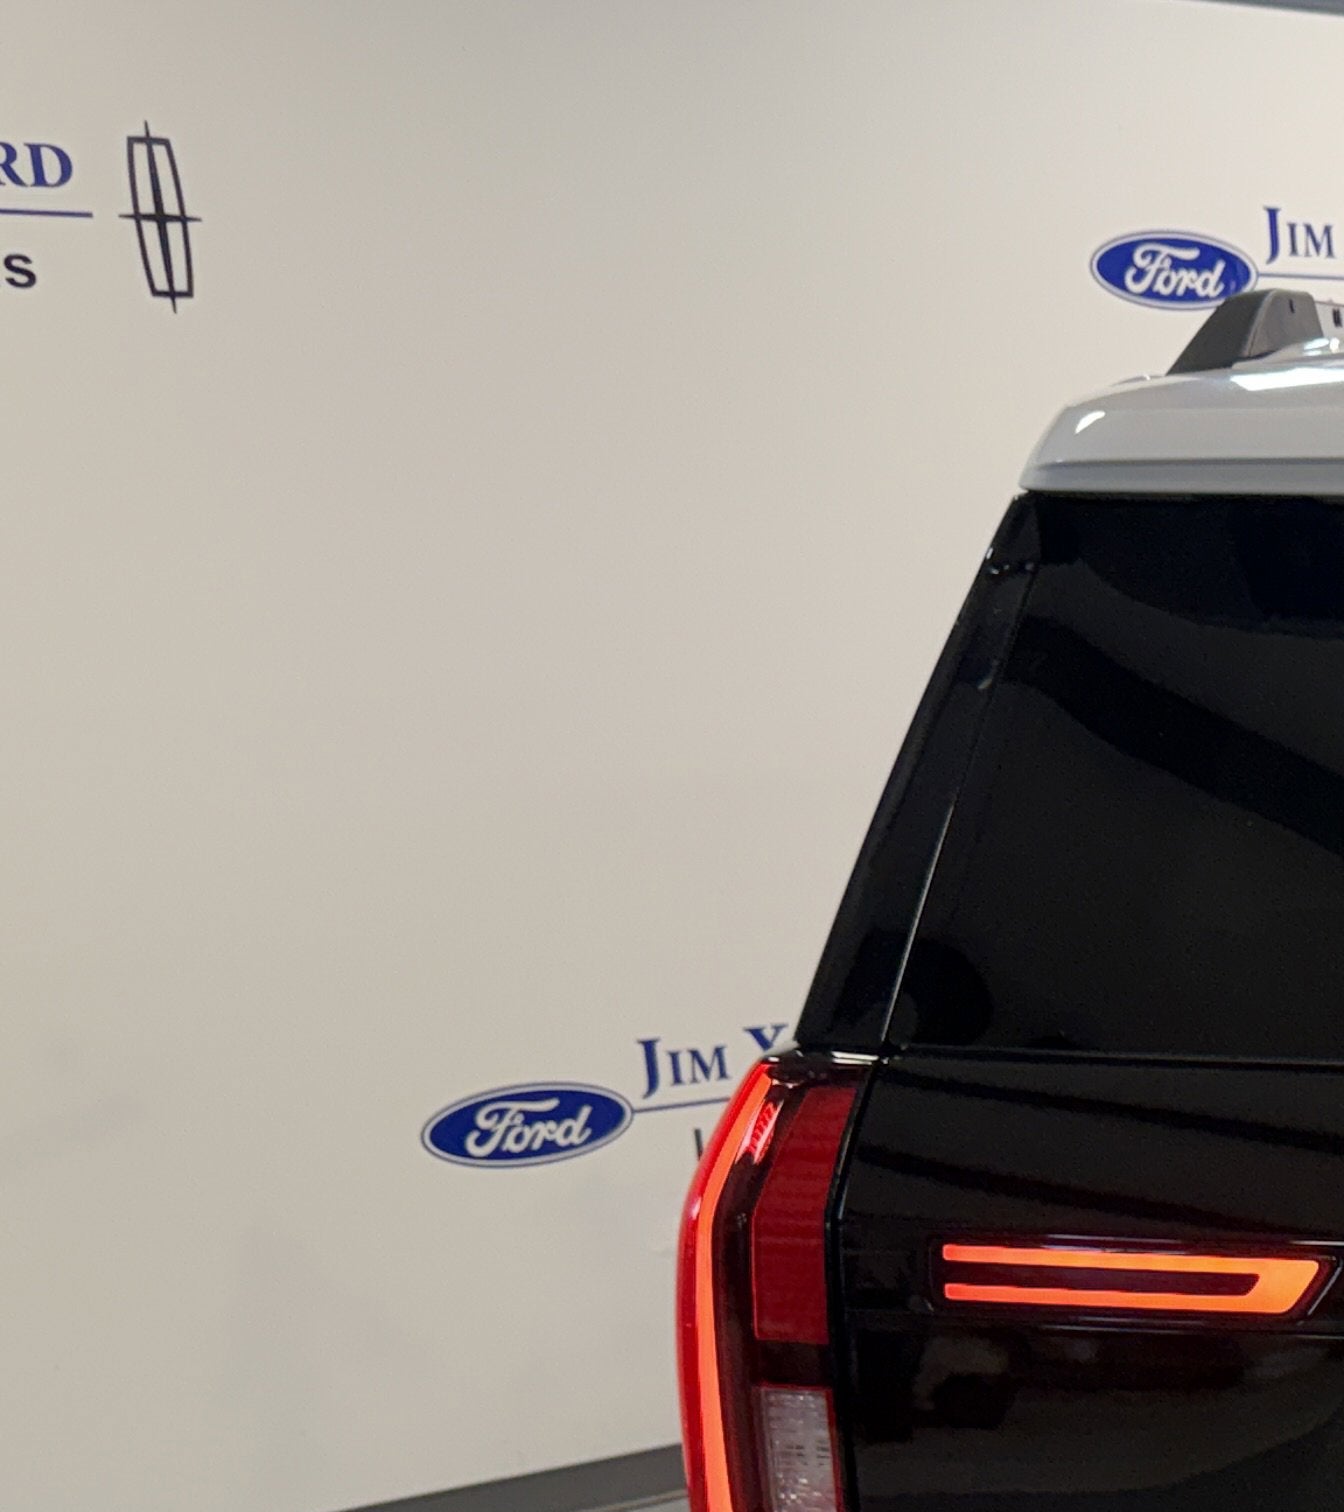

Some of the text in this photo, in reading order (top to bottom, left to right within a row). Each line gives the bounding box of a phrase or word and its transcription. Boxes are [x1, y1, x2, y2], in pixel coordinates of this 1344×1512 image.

[0, 141, 73, 188] RD
[1263, 206, 1334, 264] JIM
[1124, 242, 1224, 297] Ford
[636, 1038, 729, 1099] JIM
[465, 1098, 593, 1158] Ford
